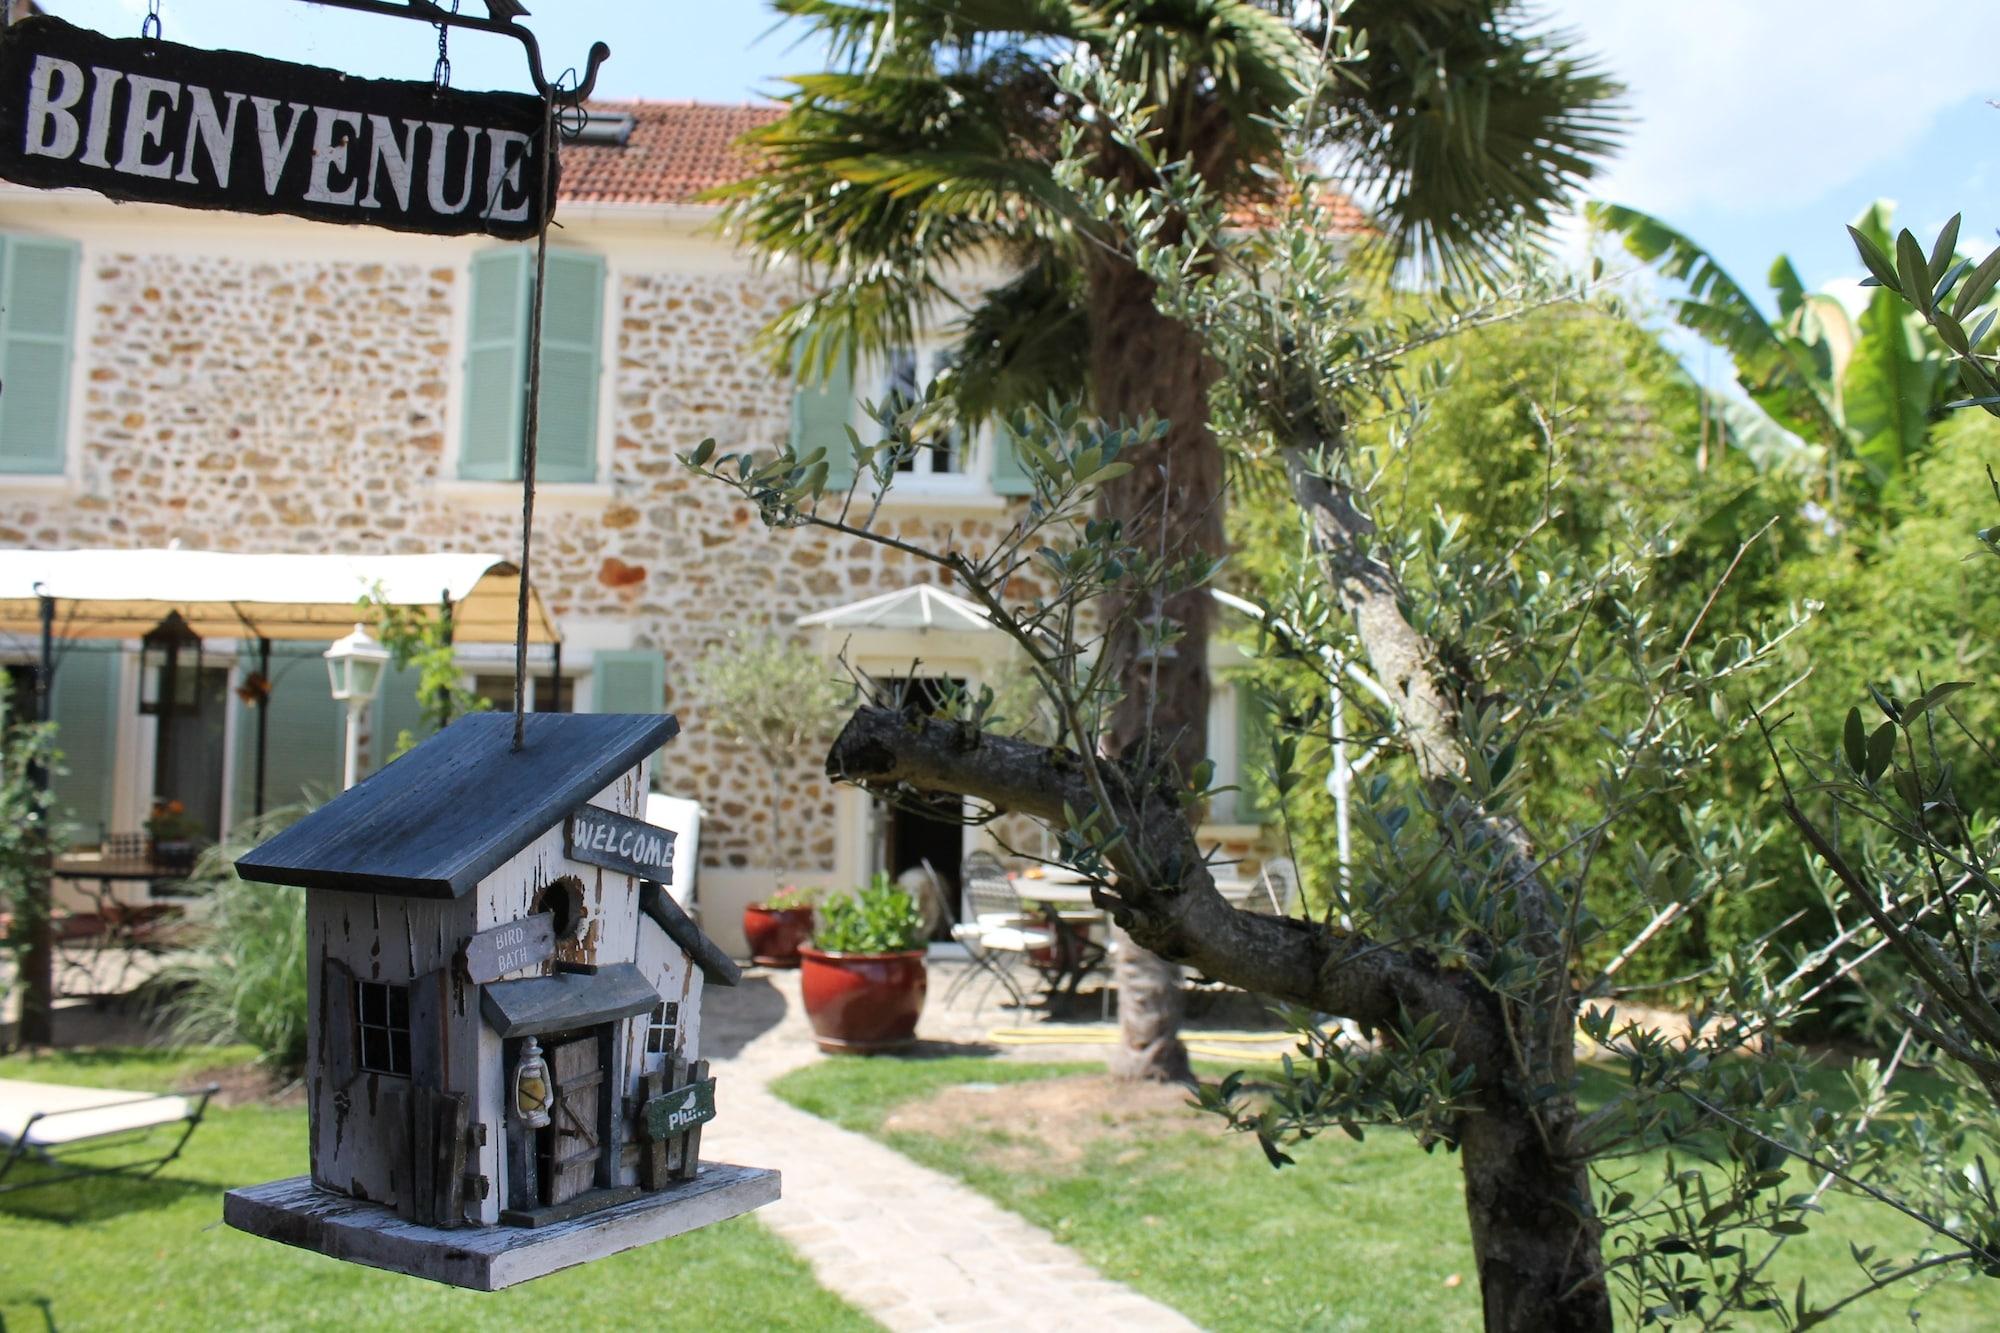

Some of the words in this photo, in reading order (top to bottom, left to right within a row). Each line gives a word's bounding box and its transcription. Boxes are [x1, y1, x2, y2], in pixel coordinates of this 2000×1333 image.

[24, 54, 534, 222] BIENVENUE
[573, 818, 675, 868] WELCOME
[495, 927, 524, 950] BIRD
[497, 946, 528, 972] BATH
